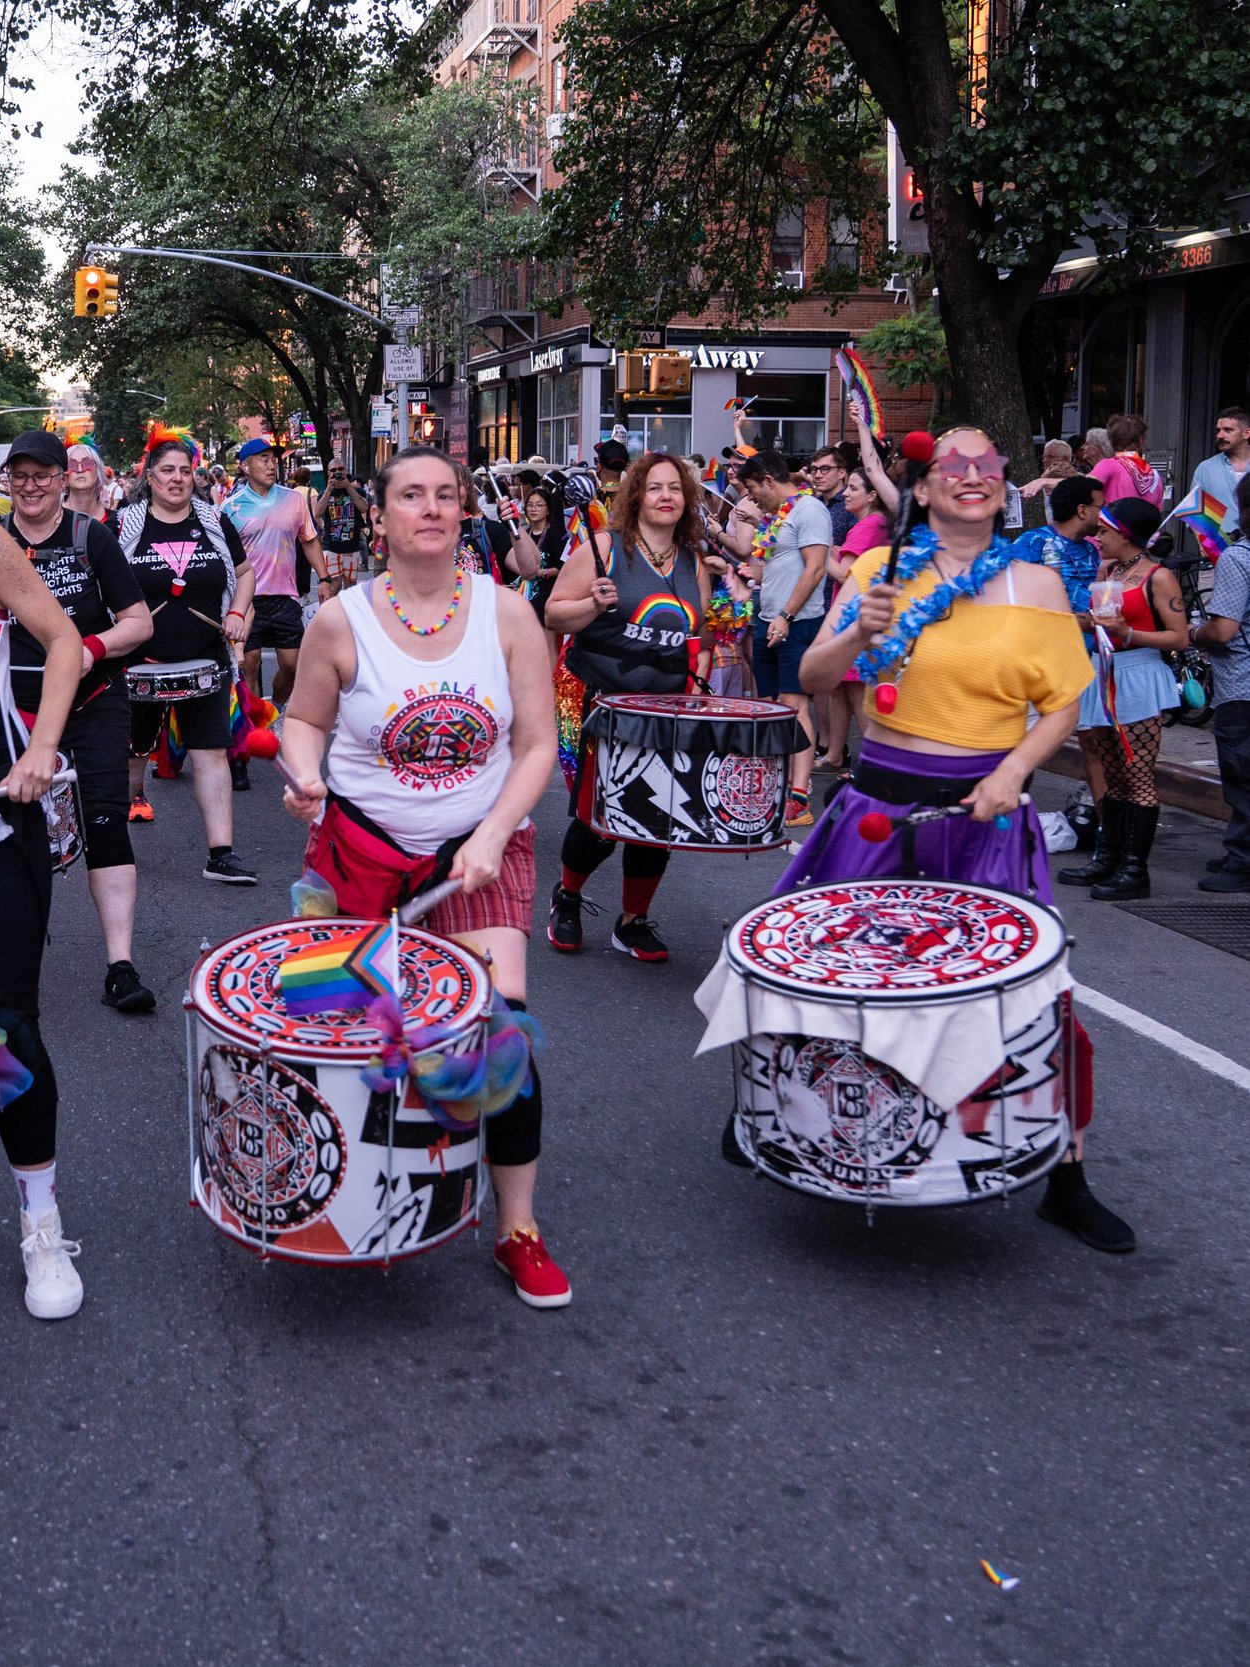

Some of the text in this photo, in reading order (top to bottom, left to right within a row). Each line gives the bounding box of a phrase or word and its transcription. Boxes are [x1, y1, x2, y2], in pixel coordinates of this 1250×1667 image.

[1181, 245, 1212, 268] 3366
[1039, 273, 1074, 294] ake Bar
[530, 346, 564, 373] LaserAway
[132, 553, 164, 565] QUEER
[40, 565, 70, 580] THERS
[62, 572, 89, 584] MEAN
[623, 622, 692, 647] BE YO
[390, 764, 478, 792] NEW YORK
[728, 819, 767, 832] MUNDO
[850, 888, 1008, 922] BATALA
[226, 1054, 299, 1101] ATALA
[816, 1156, 897, 1183] MUNDO
